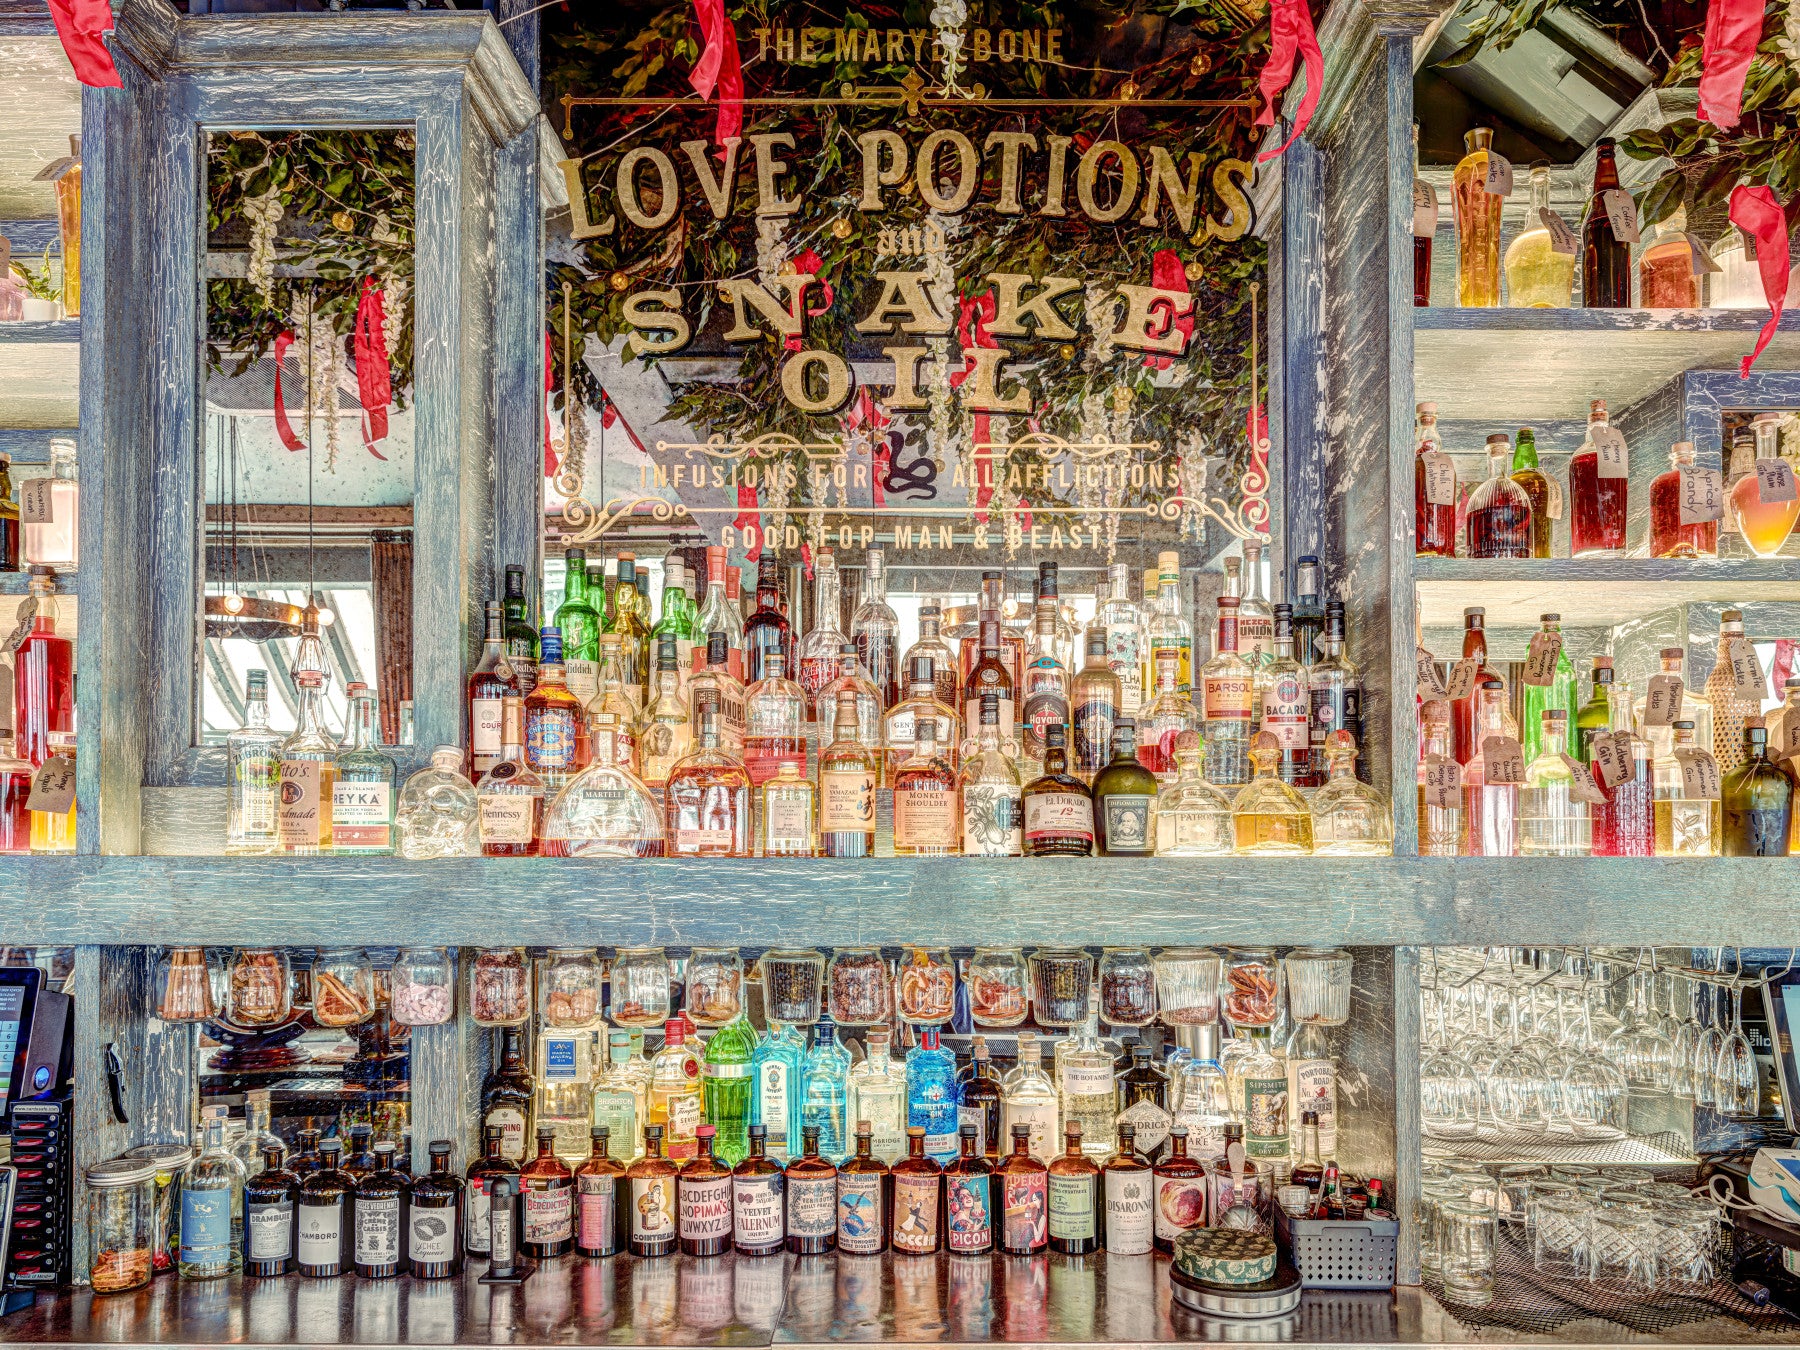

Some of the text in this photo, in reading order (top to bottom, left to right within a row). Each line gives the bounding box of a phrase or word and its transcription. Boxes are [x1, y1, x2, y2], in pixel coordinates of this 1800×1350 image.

[755, 28, 817, 62] THE
[558, 129, 1260, 244] LOVE POTIONS
[1621, 205, 1632, 230] Coffee
[877, 217, 947, 256] and
[622, 272, 1196, 356] SNAKE
[781, 348, 1034, 413] OIL
[1601, 444, 1611, 461] Rum
[1610, 439, 1621, 464] Cherry
[640, 463, 1181, 489] INFUSIONS FOR ALL AFFLICTIONS
[1439, 463, 1451, 484] Chilli
[1682, 467, 1700, 514] Brandy
[1700, 469, 1719, 512] Apricot
[721, 525, 1101, 549] GOOD FOR MAN & BEAST
[1528, 656, 1537, 671] Gin
[1546, 639, 1562, 676] Cucumber
[1733, 659, 1746, 686] Vodka
[1746, 654, 1763, 689] Marmite
[1208, 683, 1250, 693] BARSOL
[1652, 690, 1664, 709] Vodka
[894, 721, 943, 729] GENTN
[1029, 714, 1064, 724] Havana
[1599, 746, 1612, 766] Gin
[1492, 761, 1500, 777] Gin
[1685, 767, 1694, 783] Gin
[55, 770, 73, 791] Orange
[1428, 771, 1436, 786] Gin
[585, 791, 623, 799] MARTELL
[909, 791, 944, 799] MONKEY
[1056, 796, 1085, 806] DORADO
[482, 809, 522, 823] Hennessy
[1060, 807, 1073, 815] 12
[1249, 1081, 1286, 1089] SIPSMITH
[598, 1098, 632, 1106] BRIGHTON
[930, 1110, 943, 1118] GIN
[1121, 1119, 1170, 1129] NDRICK'S
[251, 1212, 291, 1223] DRAMBUIE
[743, 1207, 772, 1216] VELVET
[737, 1215, 780, 1231] FALERNUM
[633, 1231, 674, 1241] COINTREAU
[894, 1230, 936, 1246] COCCHI
[952, 1231, 988, 1246] PICON
[416, 1242, 442, 1250] LYCHEE
